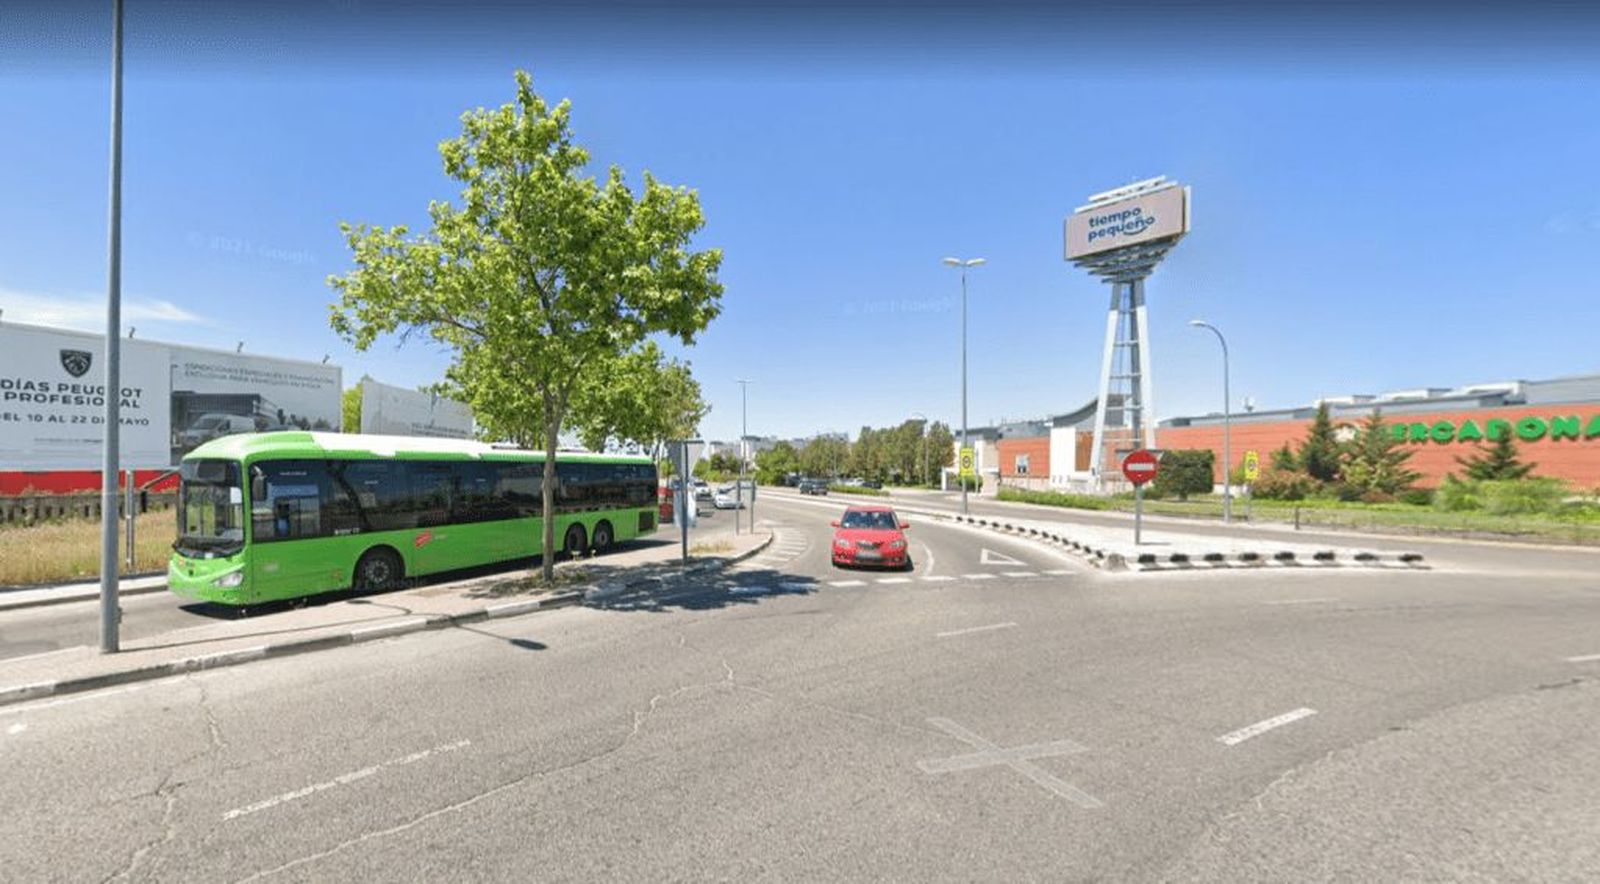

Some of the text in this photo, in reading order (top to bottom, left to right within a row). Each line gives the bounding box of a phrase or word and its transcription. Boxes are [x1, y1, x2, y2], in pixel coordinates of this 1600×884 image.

[1088, 207, 1141, 227] tiempo
[1088, 216, 1155, 242] pequeño
[0, 378, 142, 398] DÍAS PEUGOT
[4, 391, 140, 408] PROFESIOAL
[0, 412, 20, 421] EL
[48, 414, 66, 424] AL
[71, 415, 87, 424] 22
[1390, 414, 1600, 444] ERCADONA
